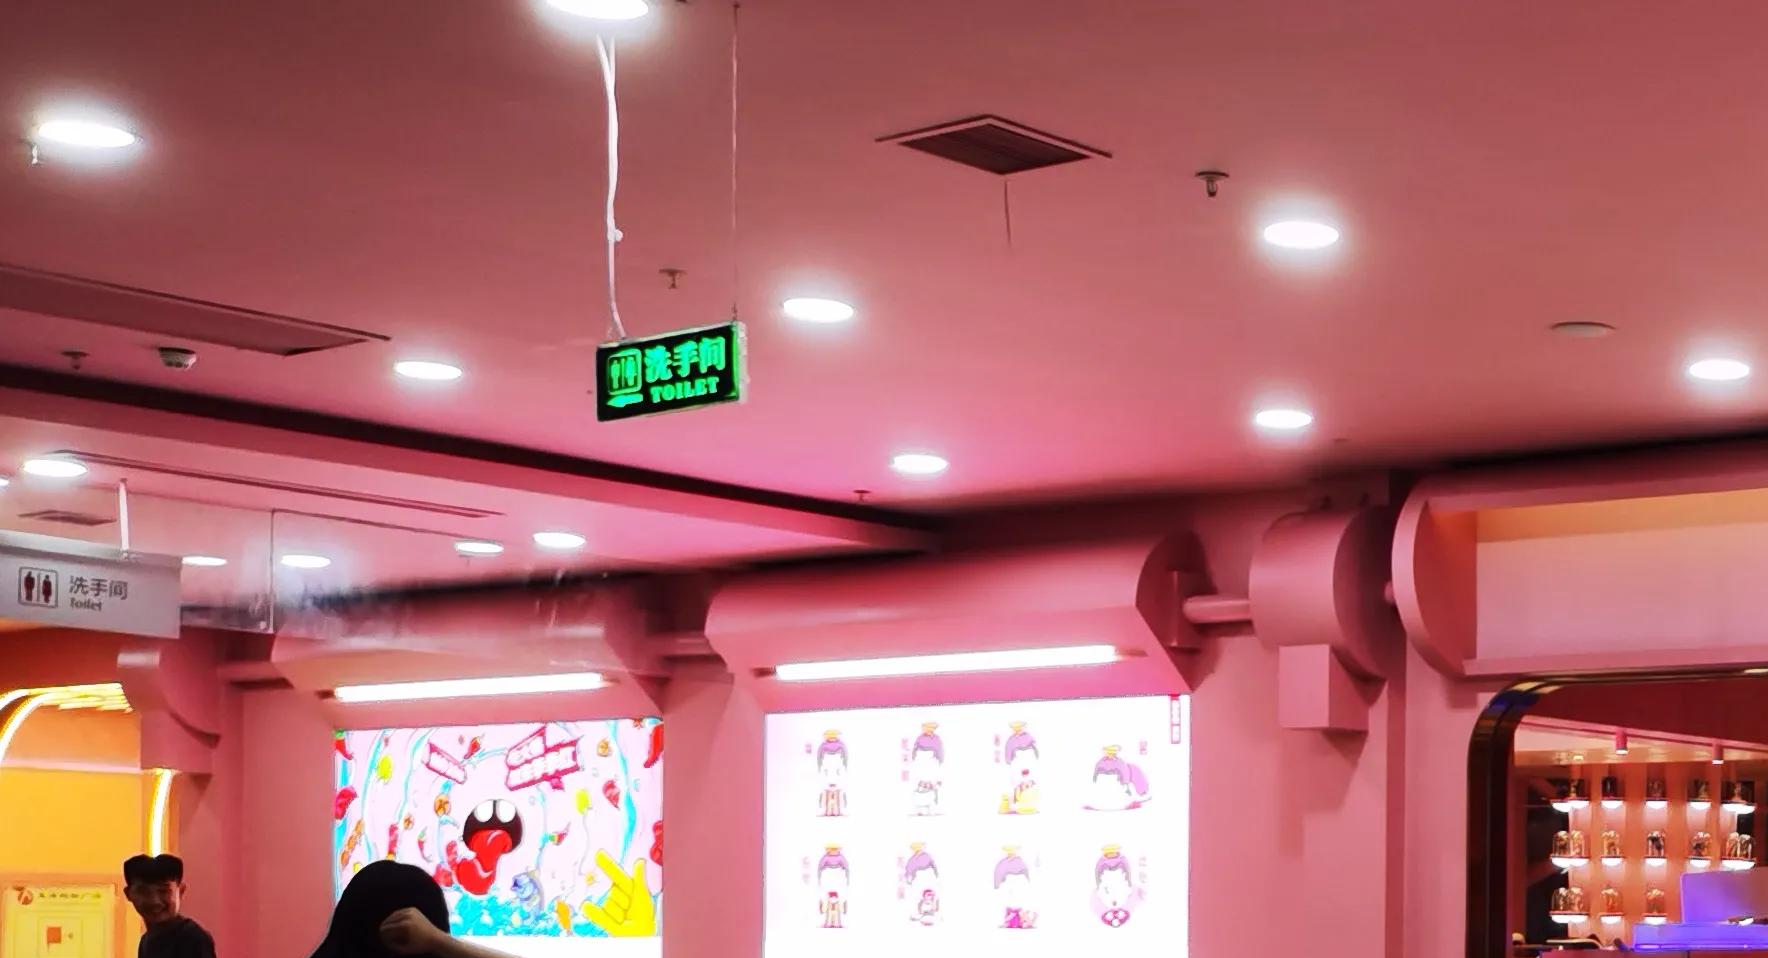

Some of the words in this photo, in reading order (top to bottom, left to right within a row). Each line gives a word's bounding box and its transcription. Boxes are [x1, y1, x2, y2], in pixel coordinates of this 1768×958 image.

[644, 336, 726, 383] 洗手间
[650, 376, 720, 403] TOILET
[69, 575, 129, 600] 洗手间
[69, 597, 103, 612] Toilet
